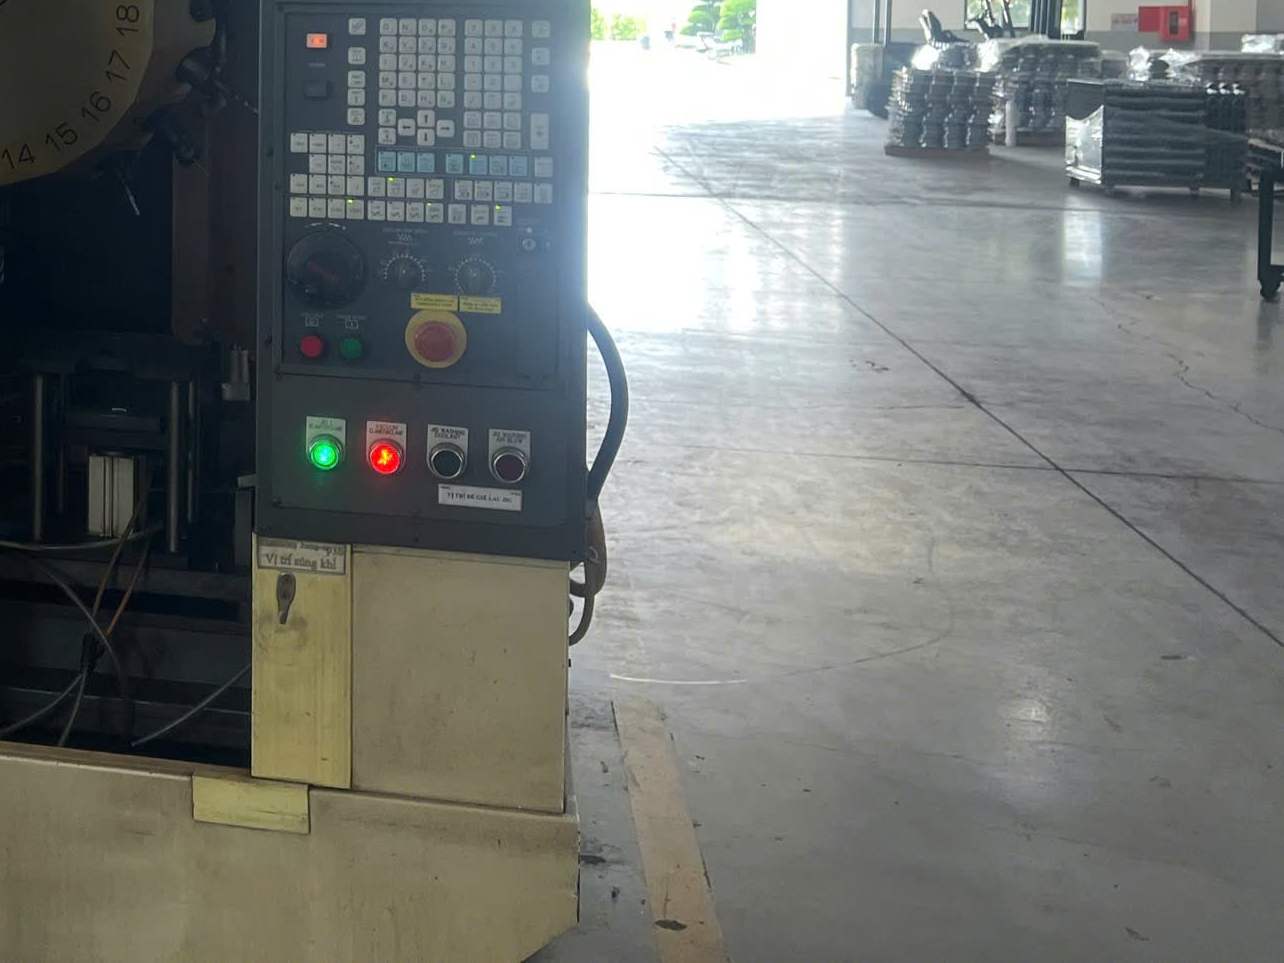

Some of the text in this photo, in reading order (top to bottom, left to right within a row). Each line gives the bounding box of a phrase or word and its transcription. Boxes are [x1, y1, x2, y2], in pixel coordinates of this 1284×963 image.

[115, 4, 140, 37] 18
[105, 49, 131, 83] 17
[81, 91, 112, 123] 16
[45, 122, 79, 152] 15
[1, 143, 35, 170] 14
[265, 552, 277, 566] Vị
[280, 553, 293, 566] trí
[320, 556, 337, 570] khí
